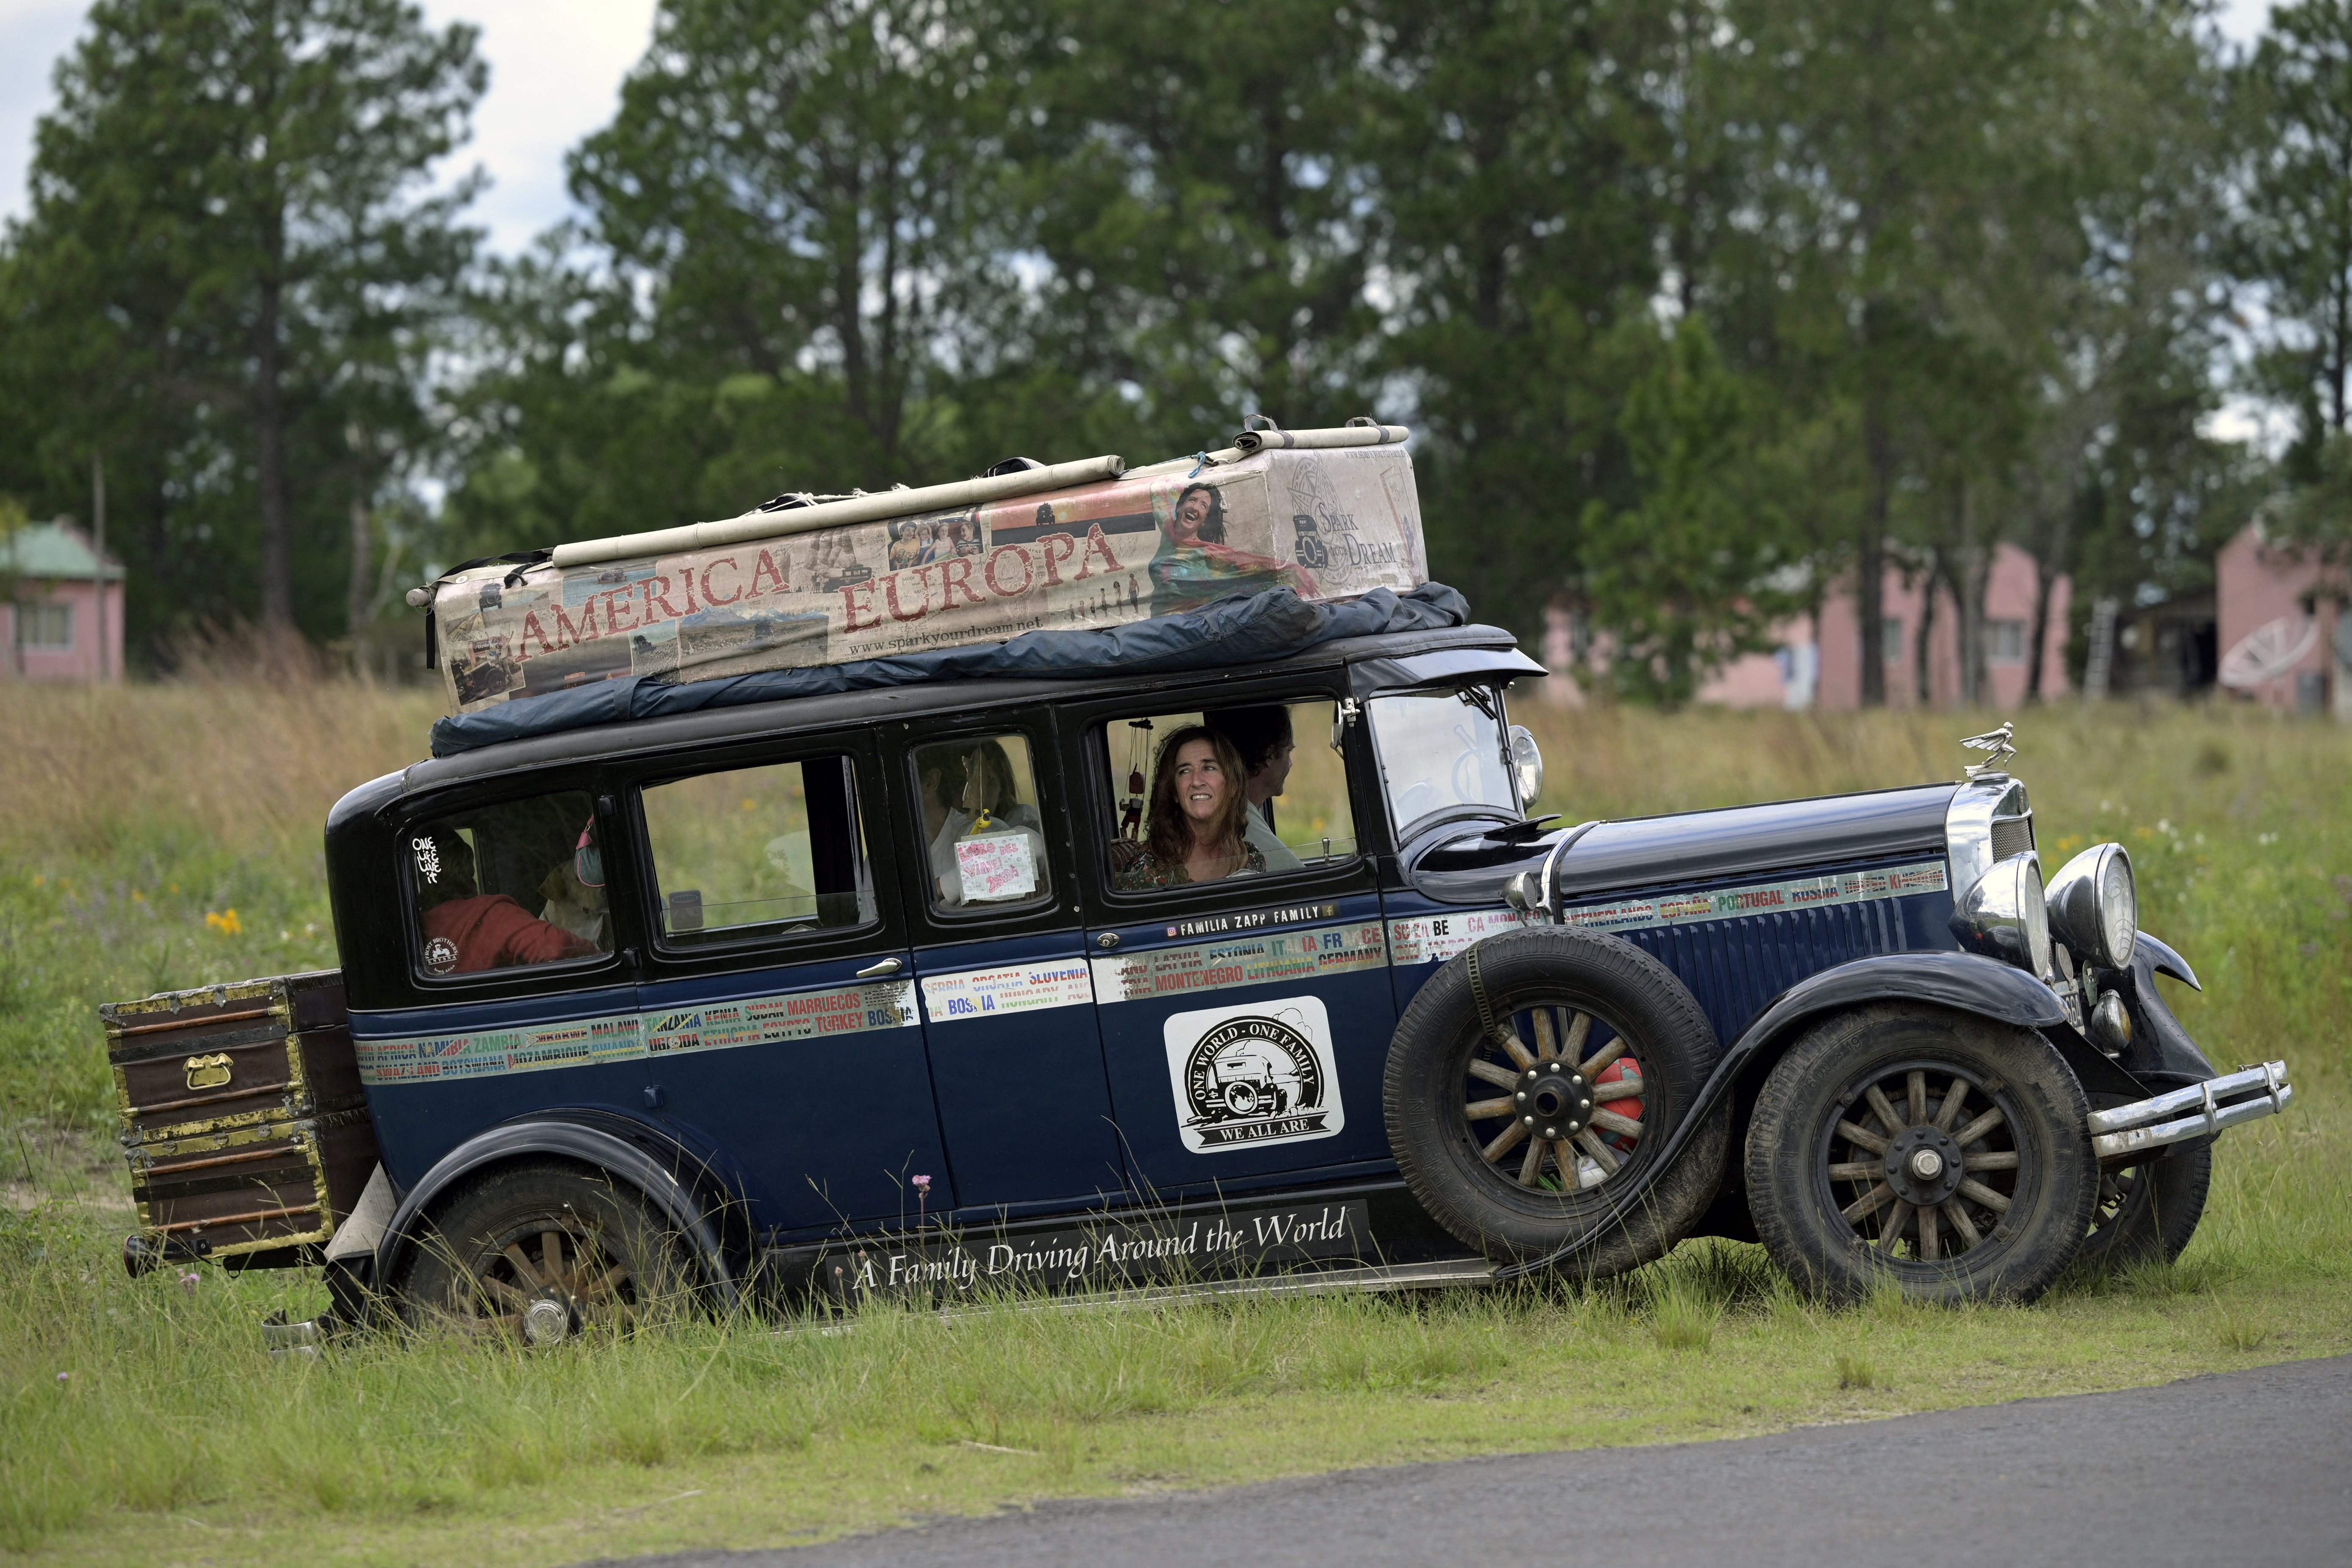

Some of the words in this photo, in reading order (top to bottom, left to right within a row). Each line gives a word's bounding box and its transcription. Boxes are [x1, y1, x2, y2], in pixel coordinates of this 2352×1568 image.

[1344, 448, 1408, 462] www.sparkyourdream.n
[1319, 502, 1359, 533] SPARK
[1331, 546, 1348, 556] YOUR
[1342, 533, 1397, 566] DREAM
[514, 548, 791, 664] AMERICA
[838, 523, 1125, 634] EUROPA
[848, 615, 1044, 656] www.sparkyourdream.net
[412, 837, 436, 850] ONE
[999, 843, 1018, 855] DEL
[1660, 896, 1711, 919] ESPAÑA
[1718, 890, 1784, 911] PORTUGAL
[1791, 885, 1839, 902] RUSSIA
[1180, 918, 1228, 936] FAMILIA
[1234, 913, 1266, 929] ZAPP
[1274, 905, 1319, 924] FAMILY
[1394, 922, 1429, 941] SUZA
[1565, 905, 1653, 928] NETHERLANDS
[432, 937, 457, 954] BROTHERS
[1154, 951, 1202, 971] LATVIA
[1209, 943, 1265, 962] ESTONIA
[1271, 935, 1318, 957] ITALIA
[1323, 927, 1382, 949] FRANCE
[445, 965, 455, 973] Africa
[923, 979, 966, 994] SERBIA
[972, 972, 1024, 992] CROATIA
[1029, 968, 1088, 985] SLOVENIA
[1155, 965, 1243, 991] MONTENEGRO
[1246, 956, 1316, 980] LITHUANIA
[1318, 947, 1382, 970] GERMANY
[948, 994, 996, 1015] BOSNIA
[999, 986, 1059, 1009] HUNGARY
[377, 1044, 416, 1061] AFRICA
[418, 1039, 472, 1058] NAMIBIA
[474, 1032, 523, 1054] ZAMBIA
[591, 1019, 640, 1040] MALAWI
[645, 1012, 702, 1033] TANZANIA
[705, 1007, 741, 1026] KENIA
[744, 1002, 784, 1021] SUDAN
[787, 993, 861, 1016] MARRUECOS
[1249, 1023, 1280, 1040] ONE
[376, 1061, 440, 1081] SWAZILAND
[442, 1054, 506, 1076] BOTSWANA
[508, 1045, 589, 1070] MOZAMBIQUE
[592, 1039, 644, 1056] RWANDA
[649, 1032, 700, 1052] UGANDA
[703, 1024, 761, 1046] ETHIOPIA
[763, 1018, 811, 1039] EGYPTO
[815, 1011, 863, 1032] TURKEY
[1196, 1027, 1238, 1066] WORLD
[1279, 1033, 1314, 1086] FAMILY
[1605, 980, 1691, 1112] MICHELIN
[1193, 1070, 1206, 1101] ONE
[1220, 1126, 1244, 1142] WE
[1248, 1123, 1277, 1138] ALL
[1280, 1119, 1310, 1134] ARE
[1408, 1098, 1492, 1230] MICHELIN
[1779, 1151, 1824, 1264] CHELIN
[851, 1259, 879, 1290] A
[888, 1246, 977, 1290] Family
[988, 1239, 1088, 1278] Driving
[1095, 1221, 1198, 1264] Around
[1206, 1219, 1244, 1252] the
[1252, 1206, 1346, 1247] World
